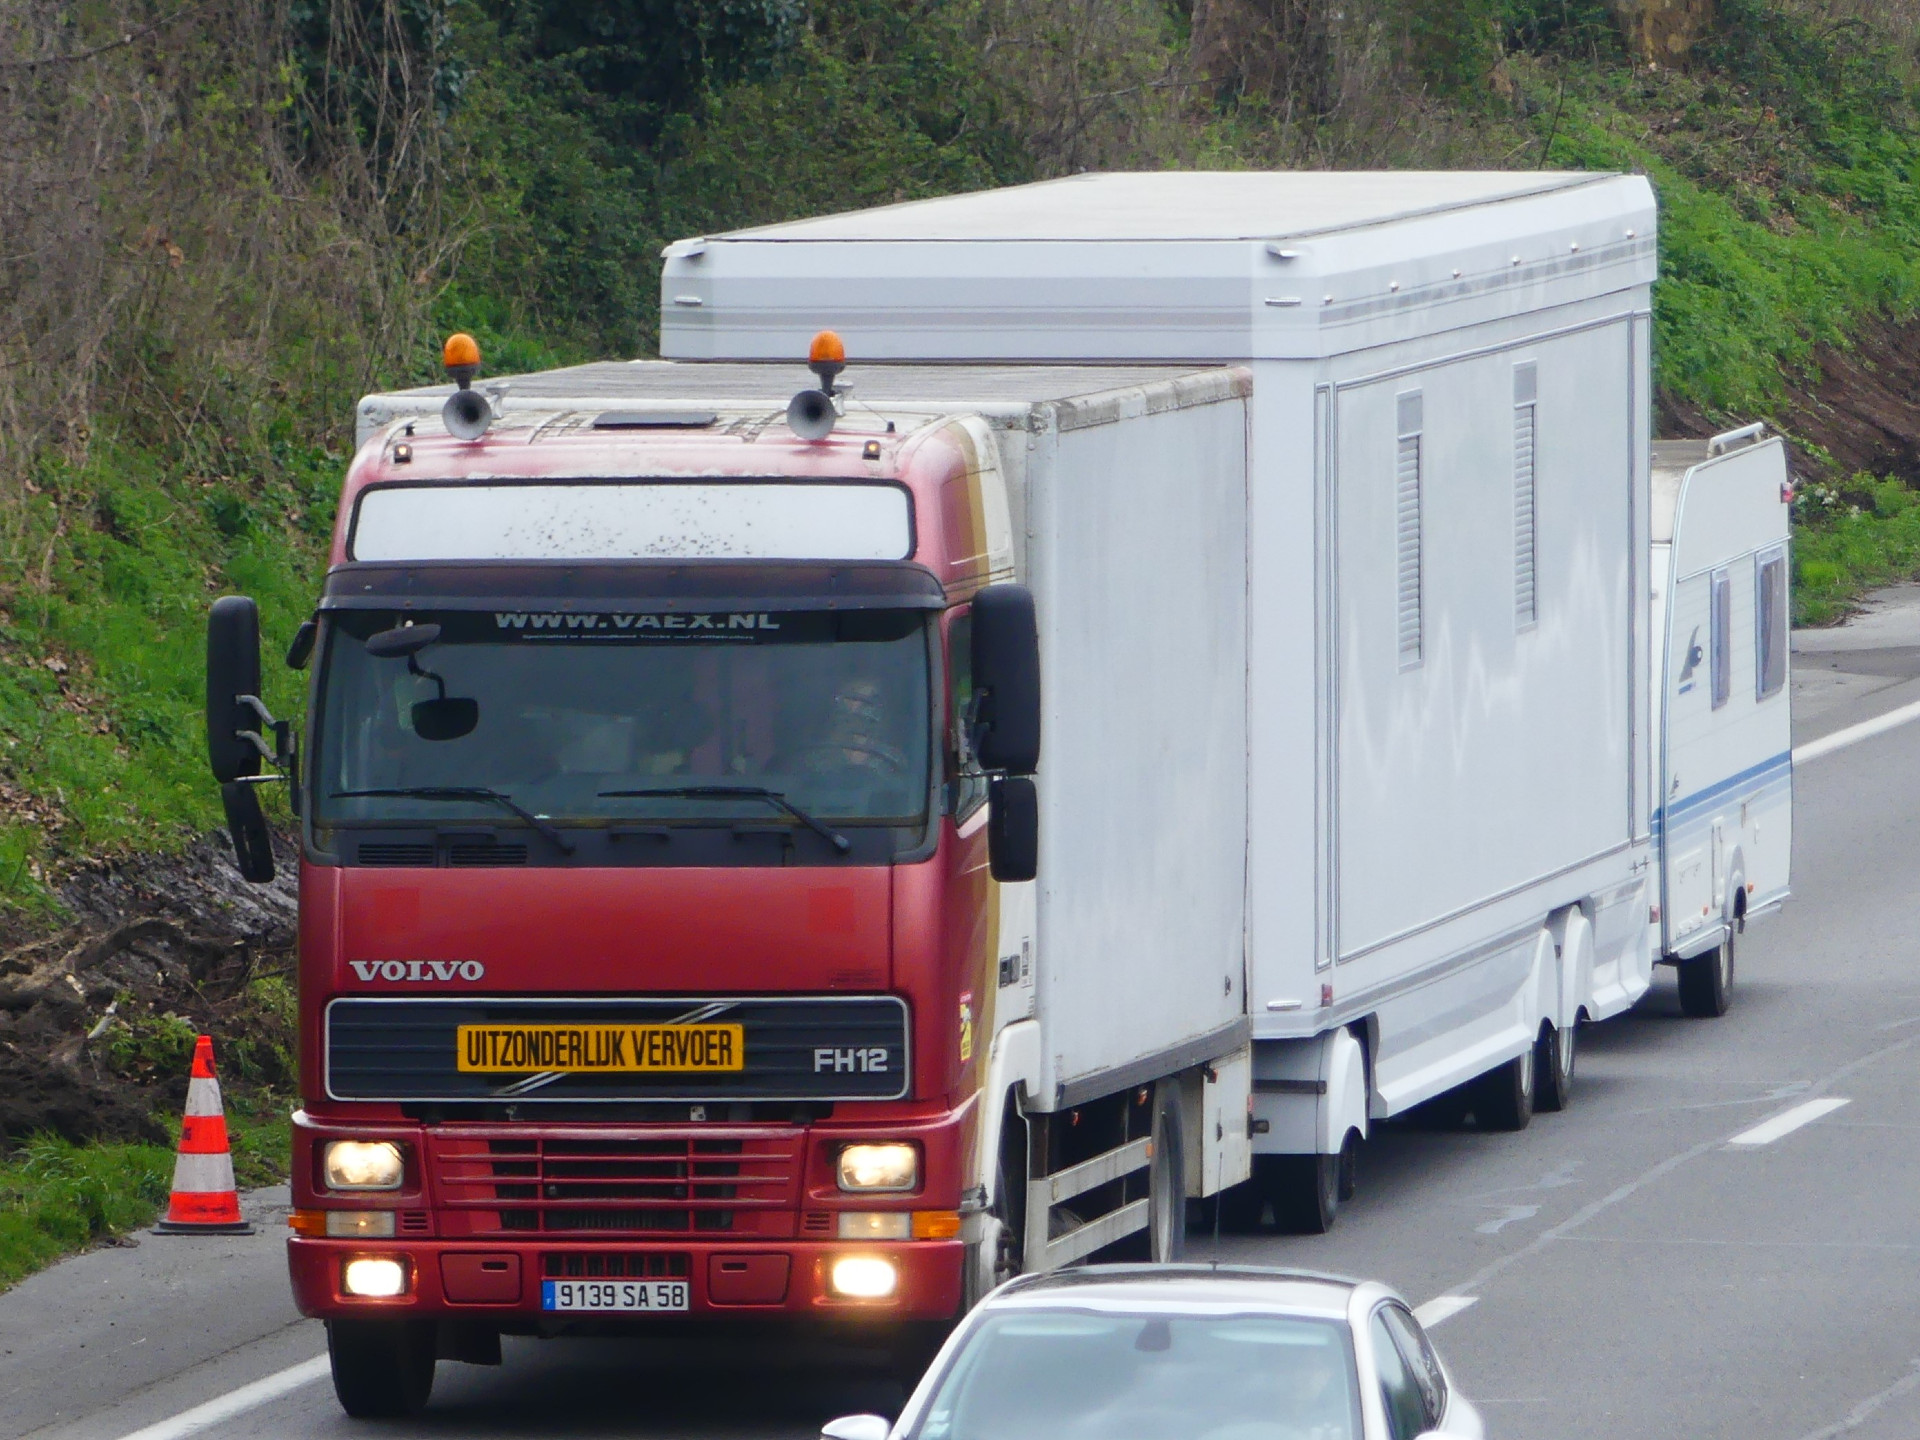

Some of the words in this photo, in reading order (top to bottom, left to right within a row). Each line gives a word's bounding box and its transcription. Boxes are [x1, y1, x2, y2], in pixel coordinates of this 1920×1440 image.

[495, 613, 780, 629] WWW.VAEX.NL
[349, 960, 484, 981] VOLVO
[467, 1030, 626, 1067] UITZONDERLIJK
[631, 1030, 733, 1066] VERVOER
[814, 1048, 888, 1072] FH12
[561, 1284, 616, 1307] 9139
[623, 1285, 649, 1307] SA
[657, 1285, 684, 1307] 58
